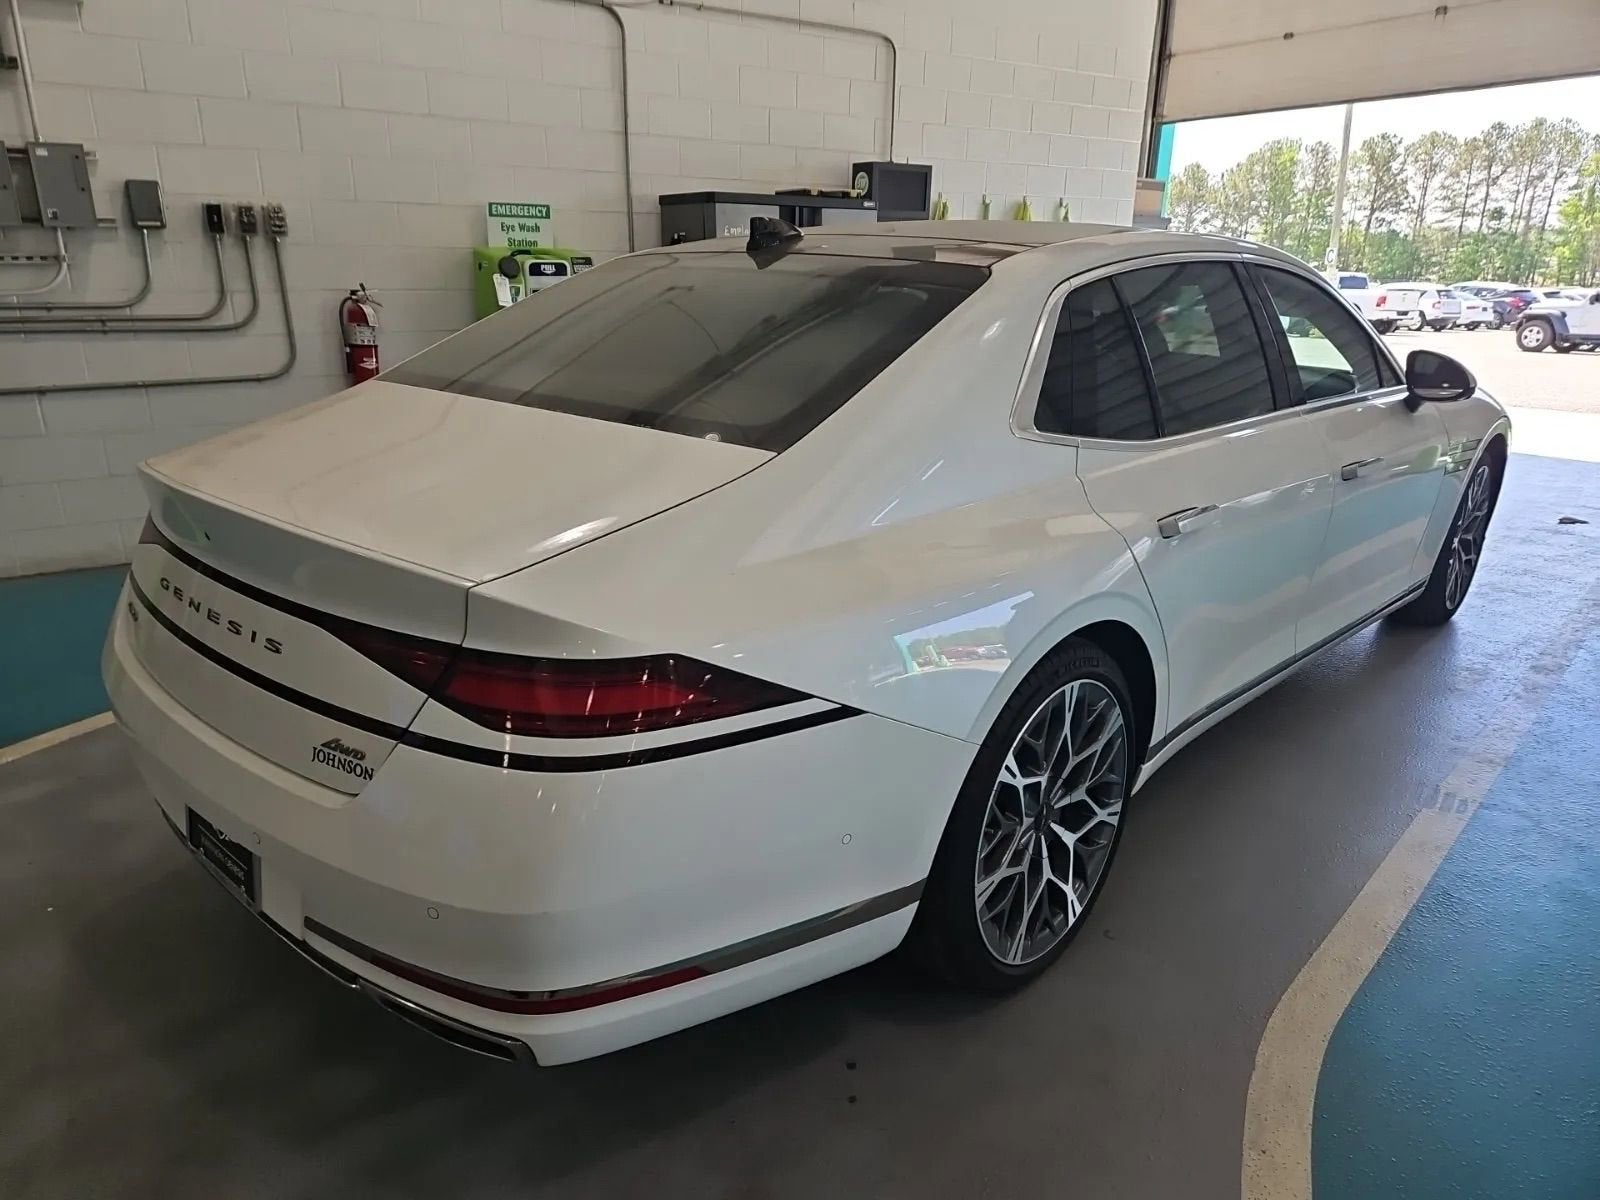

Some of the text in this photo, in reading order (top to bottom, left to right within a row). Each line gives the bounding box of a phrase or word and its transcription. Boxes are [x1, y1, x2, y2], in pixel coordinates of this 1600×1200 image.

[491, 204, 547, 217] EMERGENCY
[500, 221, 541, 234] Eye Wash
[507, 237, 538, 248] Station
[1327, 249, 1334, 263] C
[541, 264, 556, 272] PULL
[159, 576, 284, 655] GENESIS
[311, 746, 375, 781] JOHNSON
